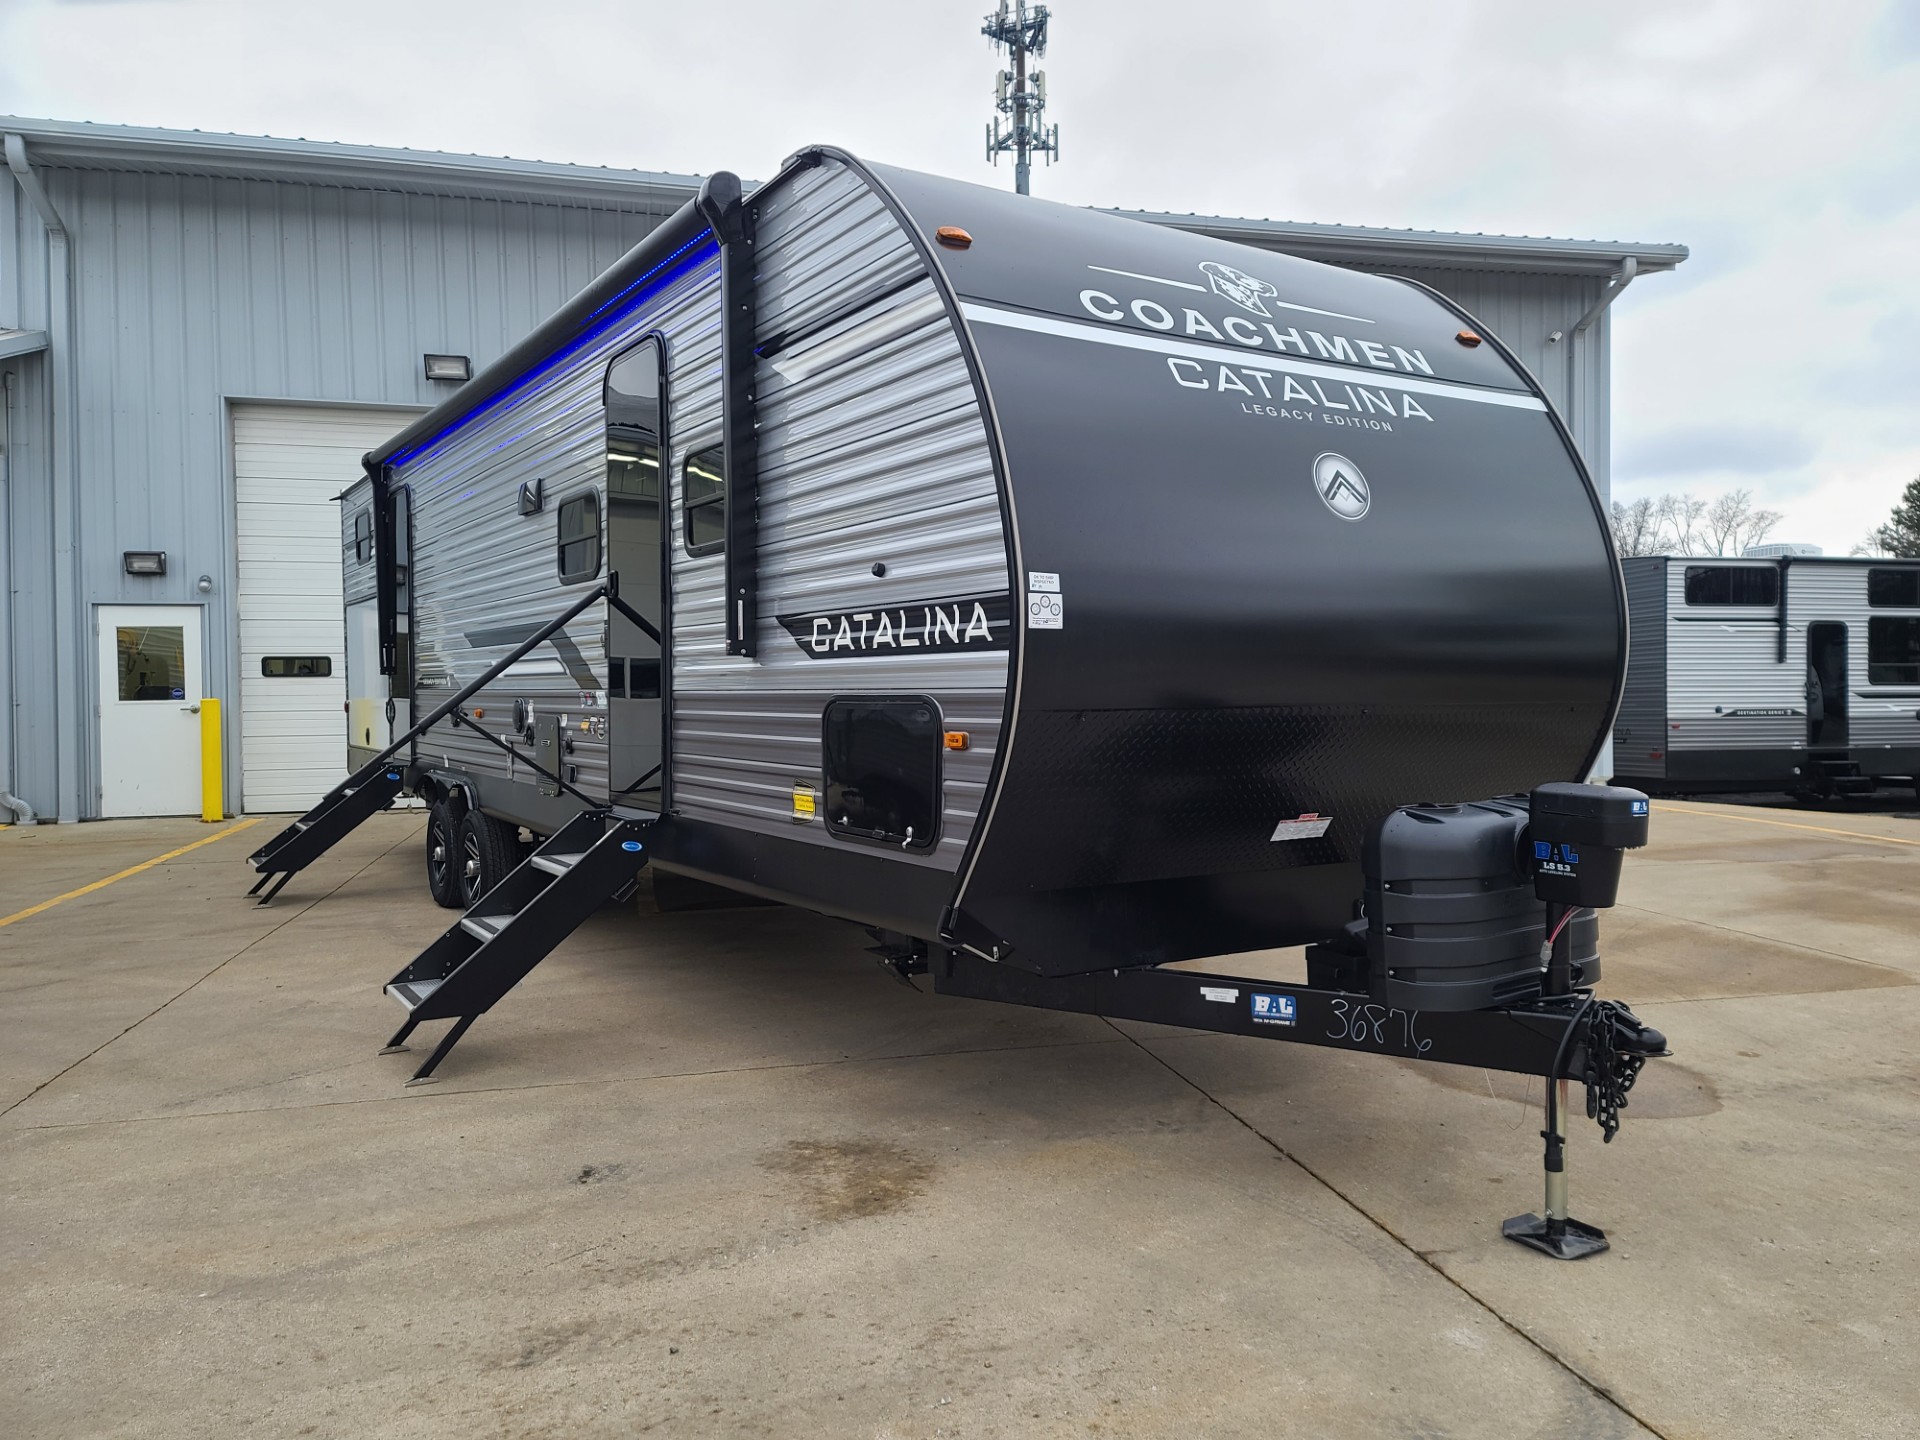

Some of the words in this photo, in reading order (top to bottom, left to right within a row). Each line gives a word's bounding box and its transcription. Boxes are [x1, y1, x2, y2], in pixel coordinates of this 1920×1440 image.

[1079, 289, 1435, 375] COACHMEN
[1166, 357, 1434, 422] CATALINA
[1240, 402, 1313, 422] LEGACY
[1322, 413, 1393, 432] EDITION
[811, 601, 993, 653] CATALINA
[1534, 841, 1579, 864] BAL
[1543, 861, 1556, 870] LS
[1556, 863, 1571, 872] 5.3
[1254, 995, 1293, 1014] BAL
[1326, 998, 1433, 1059] 36876
